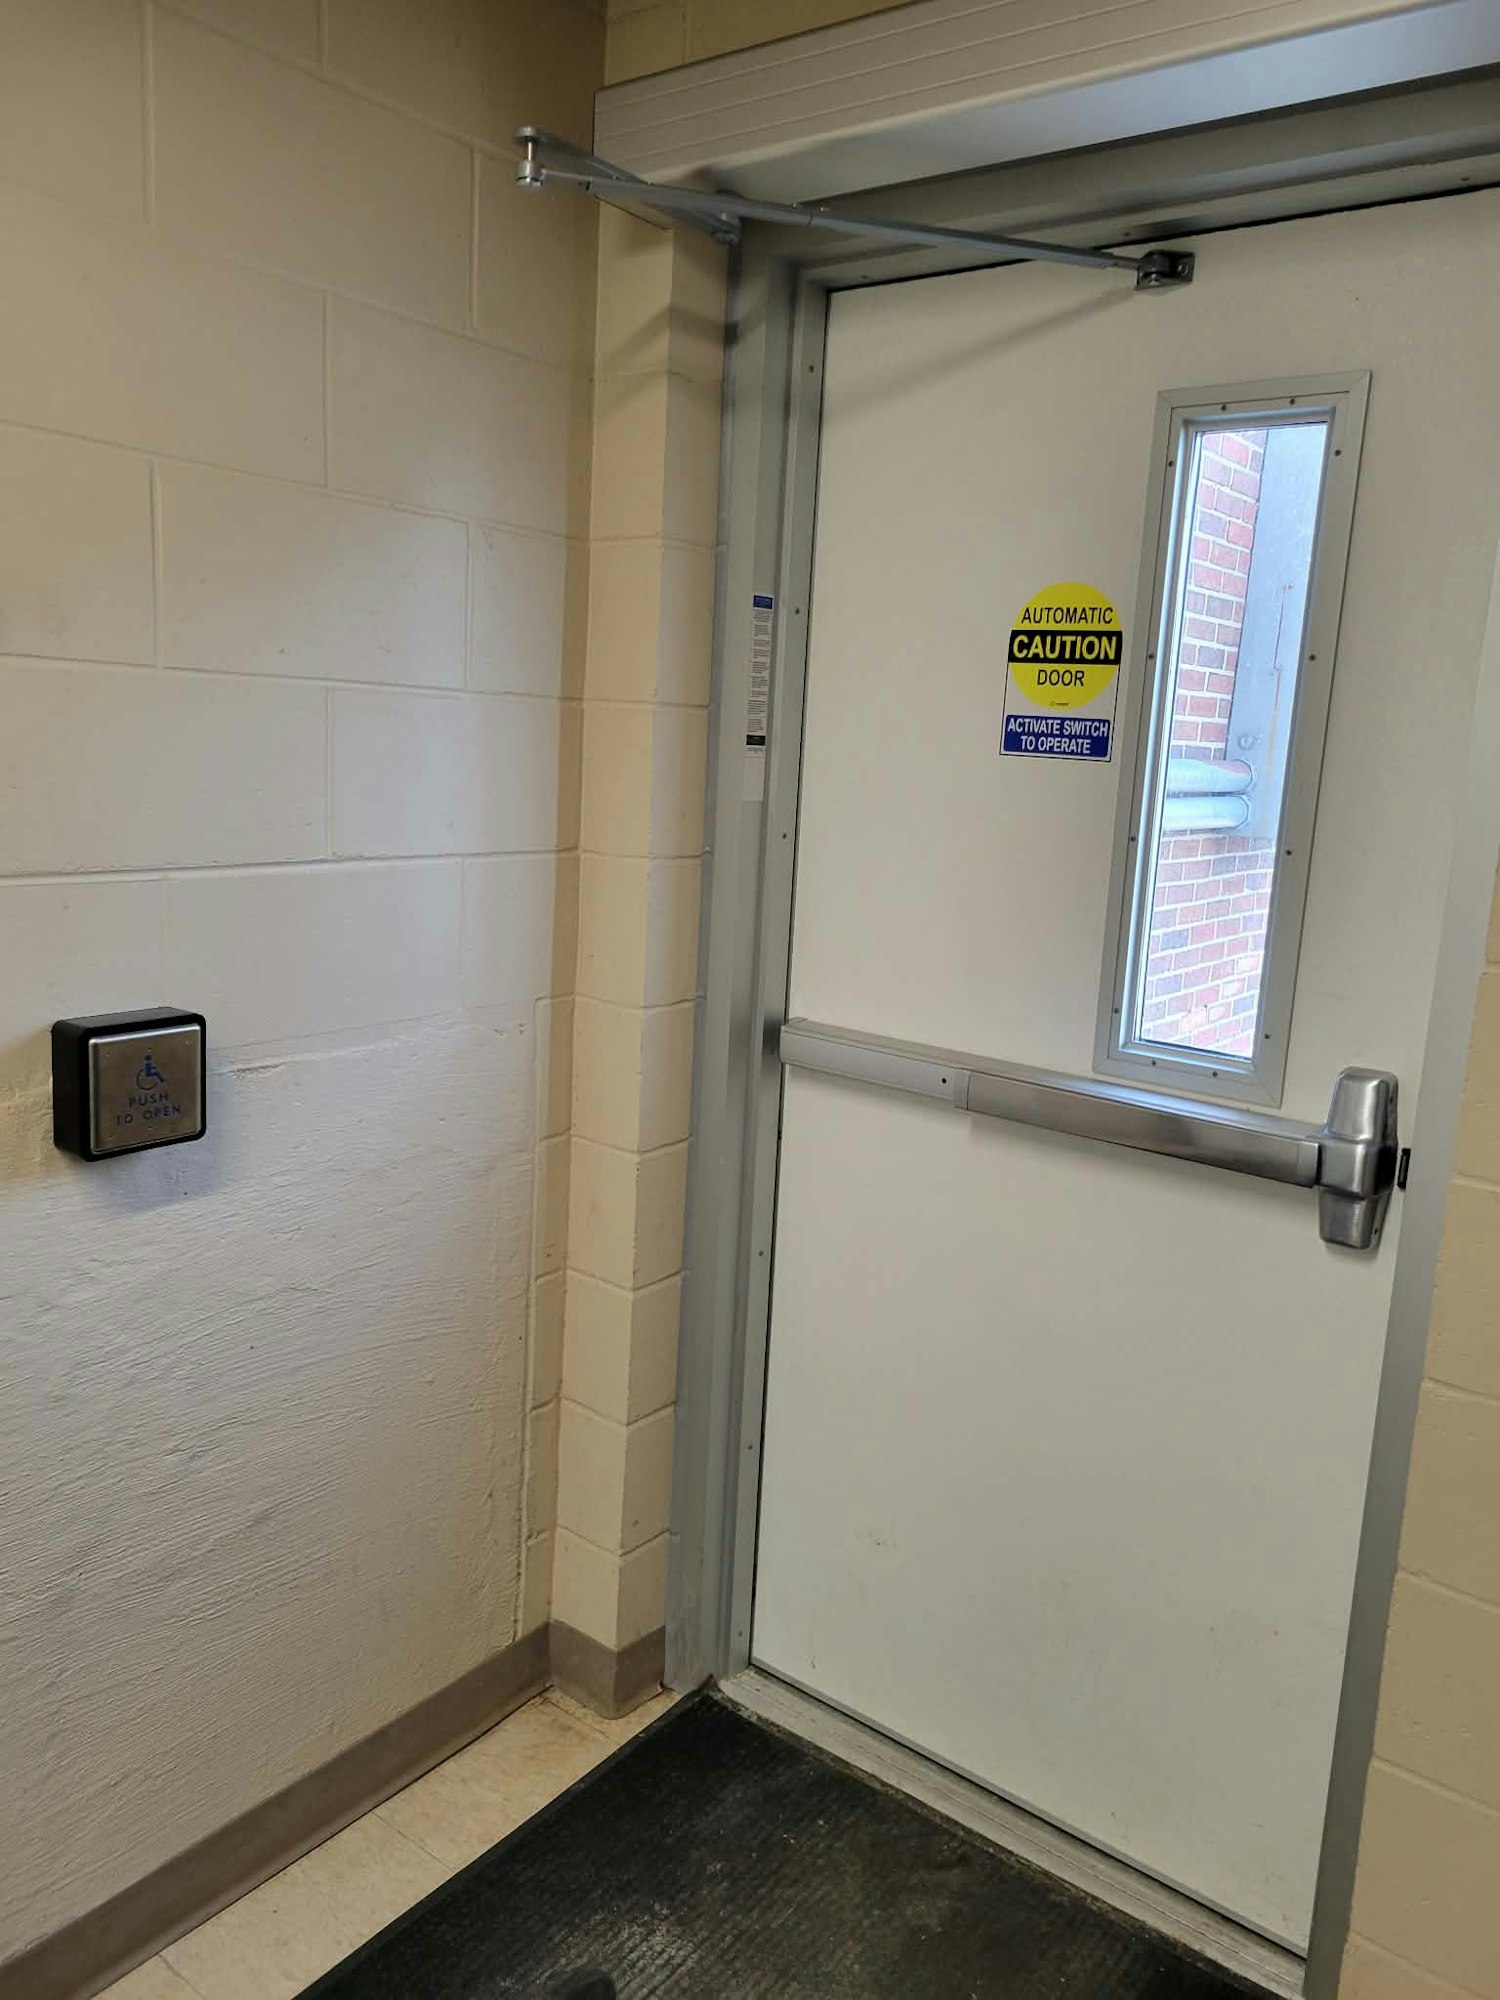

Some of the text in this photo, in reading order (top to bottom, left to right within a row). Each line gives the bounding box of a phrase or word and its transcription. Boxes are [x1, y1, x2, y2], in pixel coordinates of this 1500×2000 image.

[1021, 607, 1113, 624] AUTOMATIC
[1013, 635, 1117, 660] CAUTION
[1037, 669, 1085, 686] DOOR
[1007, 718, 1109, 737] ACTIVATE SWITCH
[1020, 735, 1092, 754] TO OPERATE
[128, 1092, 168, 1108] PUSH
[115, 1104, 181, 1125] TO OPEN
